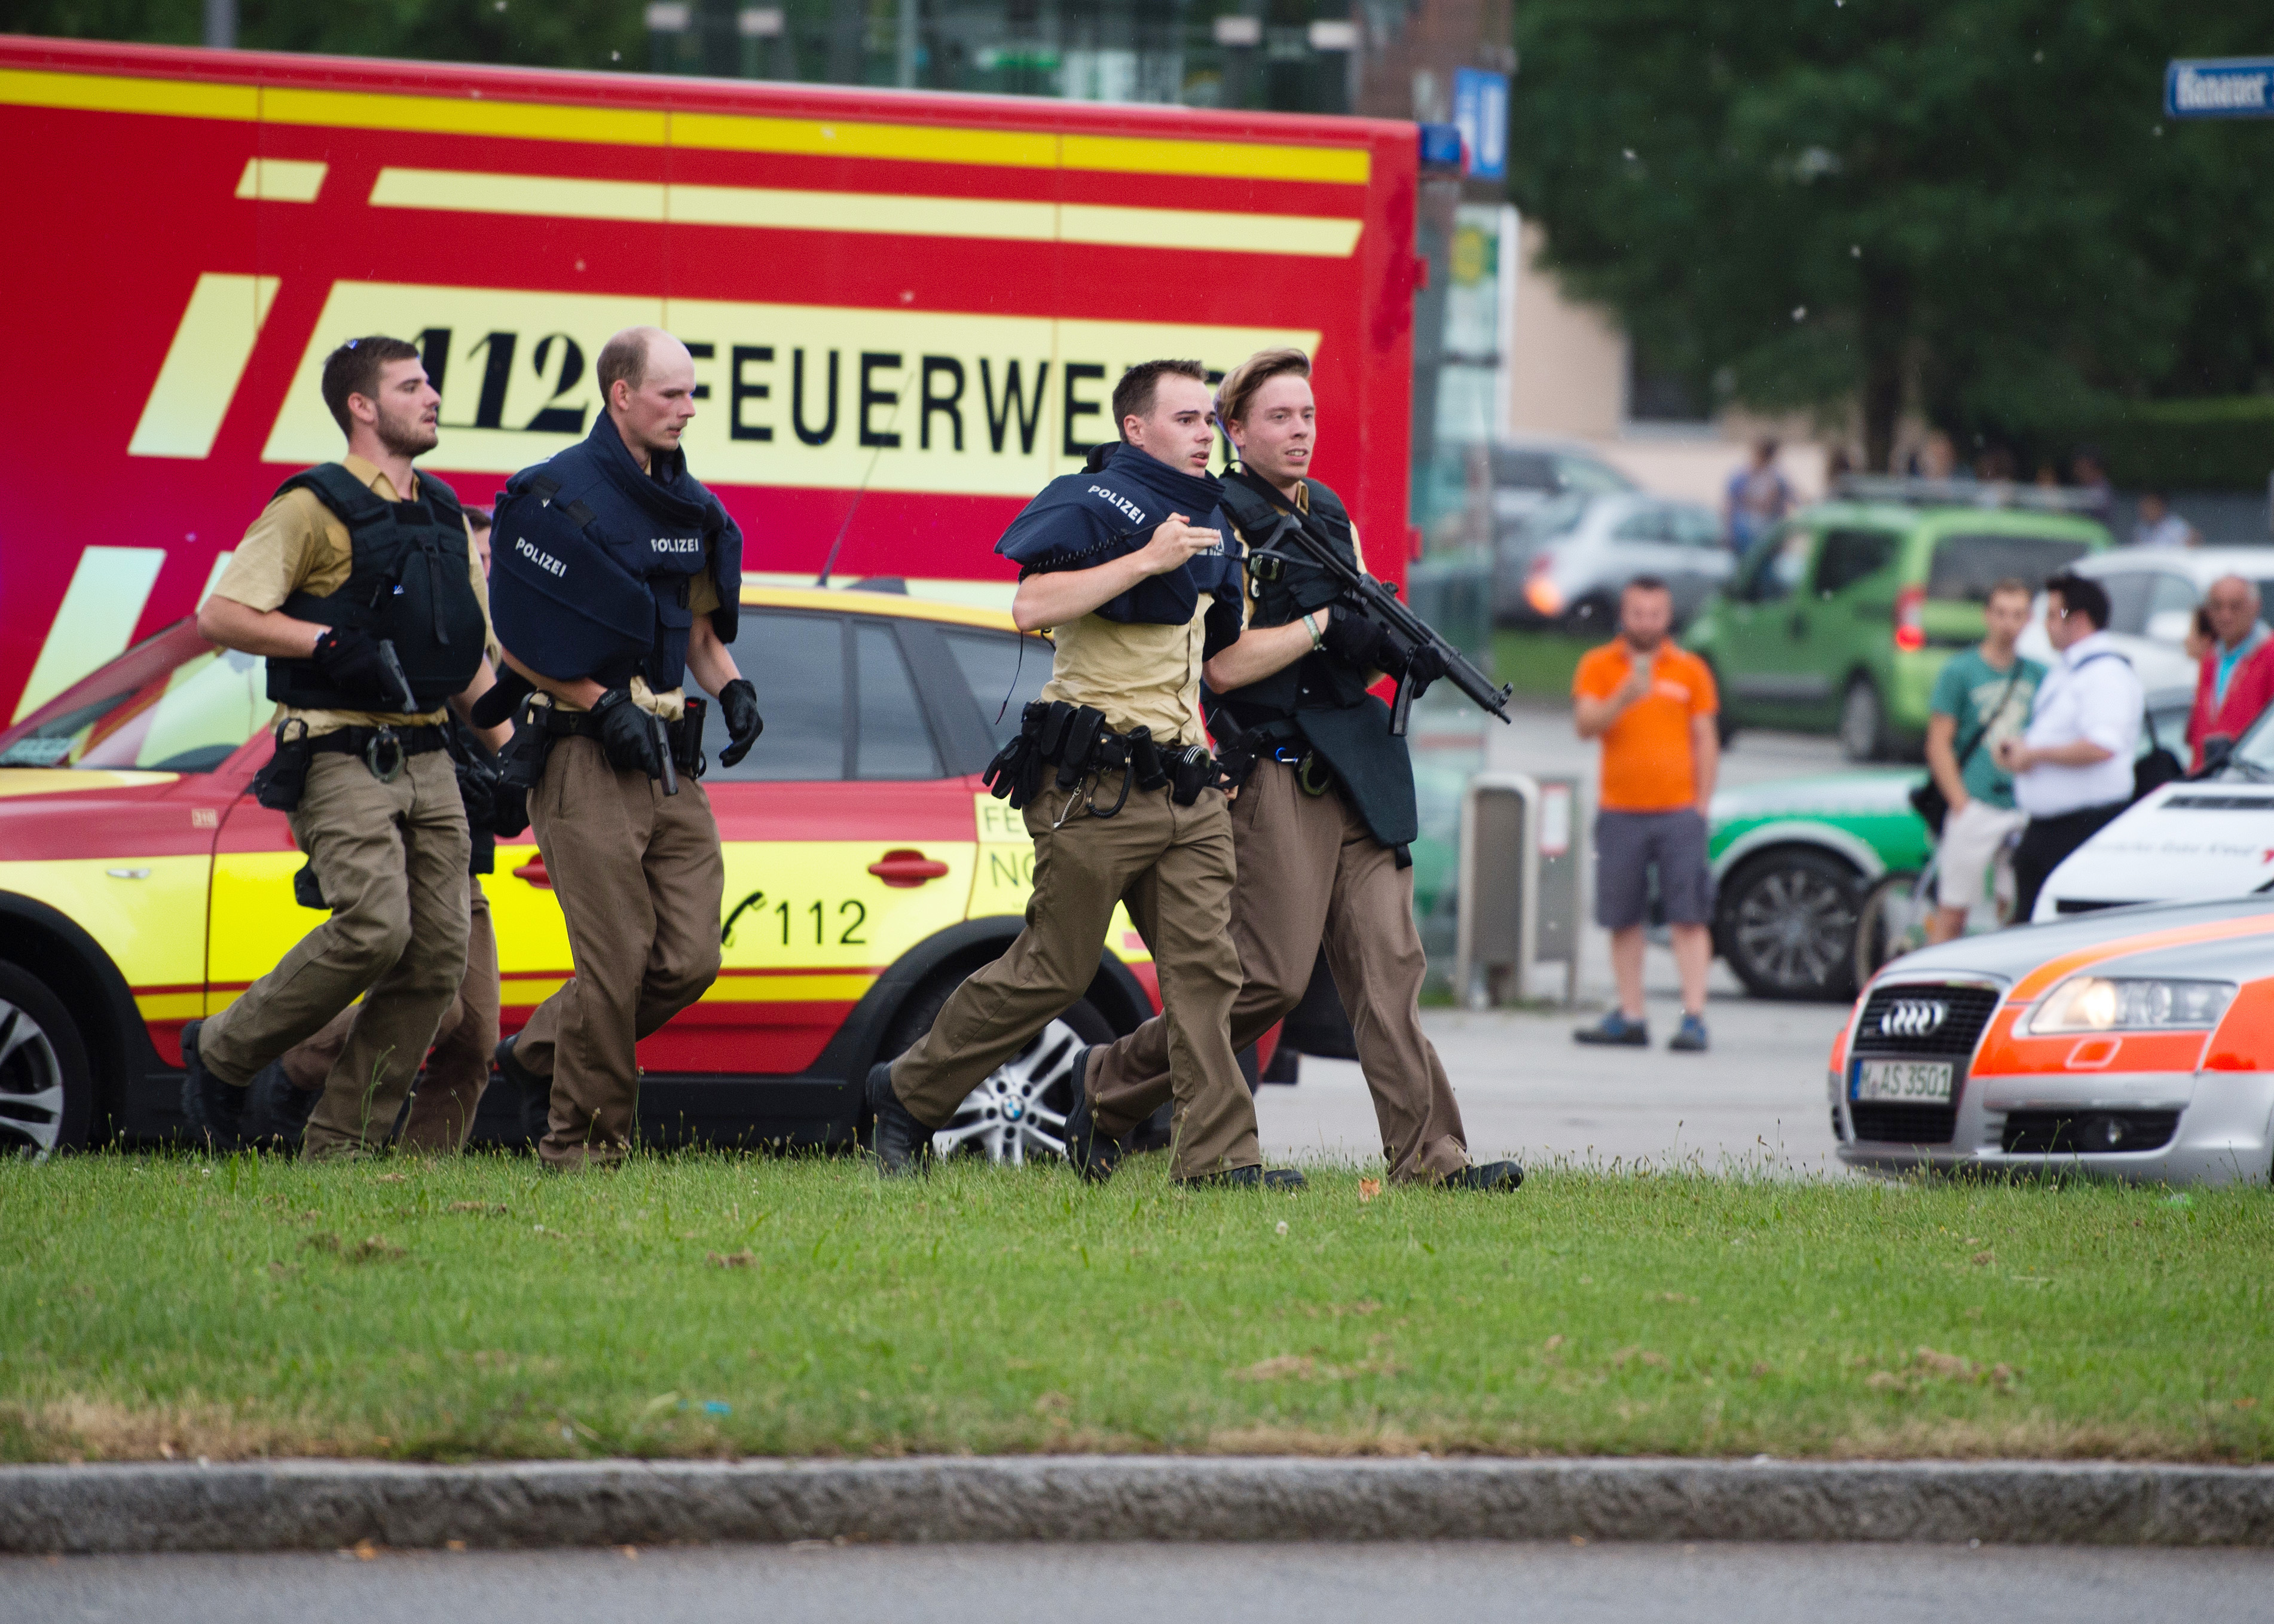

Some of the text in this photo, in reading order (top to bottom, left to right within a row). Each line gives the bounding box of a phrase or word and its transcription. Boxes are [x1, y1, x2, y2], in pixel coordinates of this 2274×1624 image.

[411, 327, 589, 435] 112
[1088, 485, 1146, 525] POLIZEI
[515, 537, 567, 577] POLIZEI
[651, 538, 699, 552] POLIZEI
[776, 898, 867, 946] 112
[1881, 1065, 1902, 1095] AS
[1905, 1065, 1951, 1096] 3501
